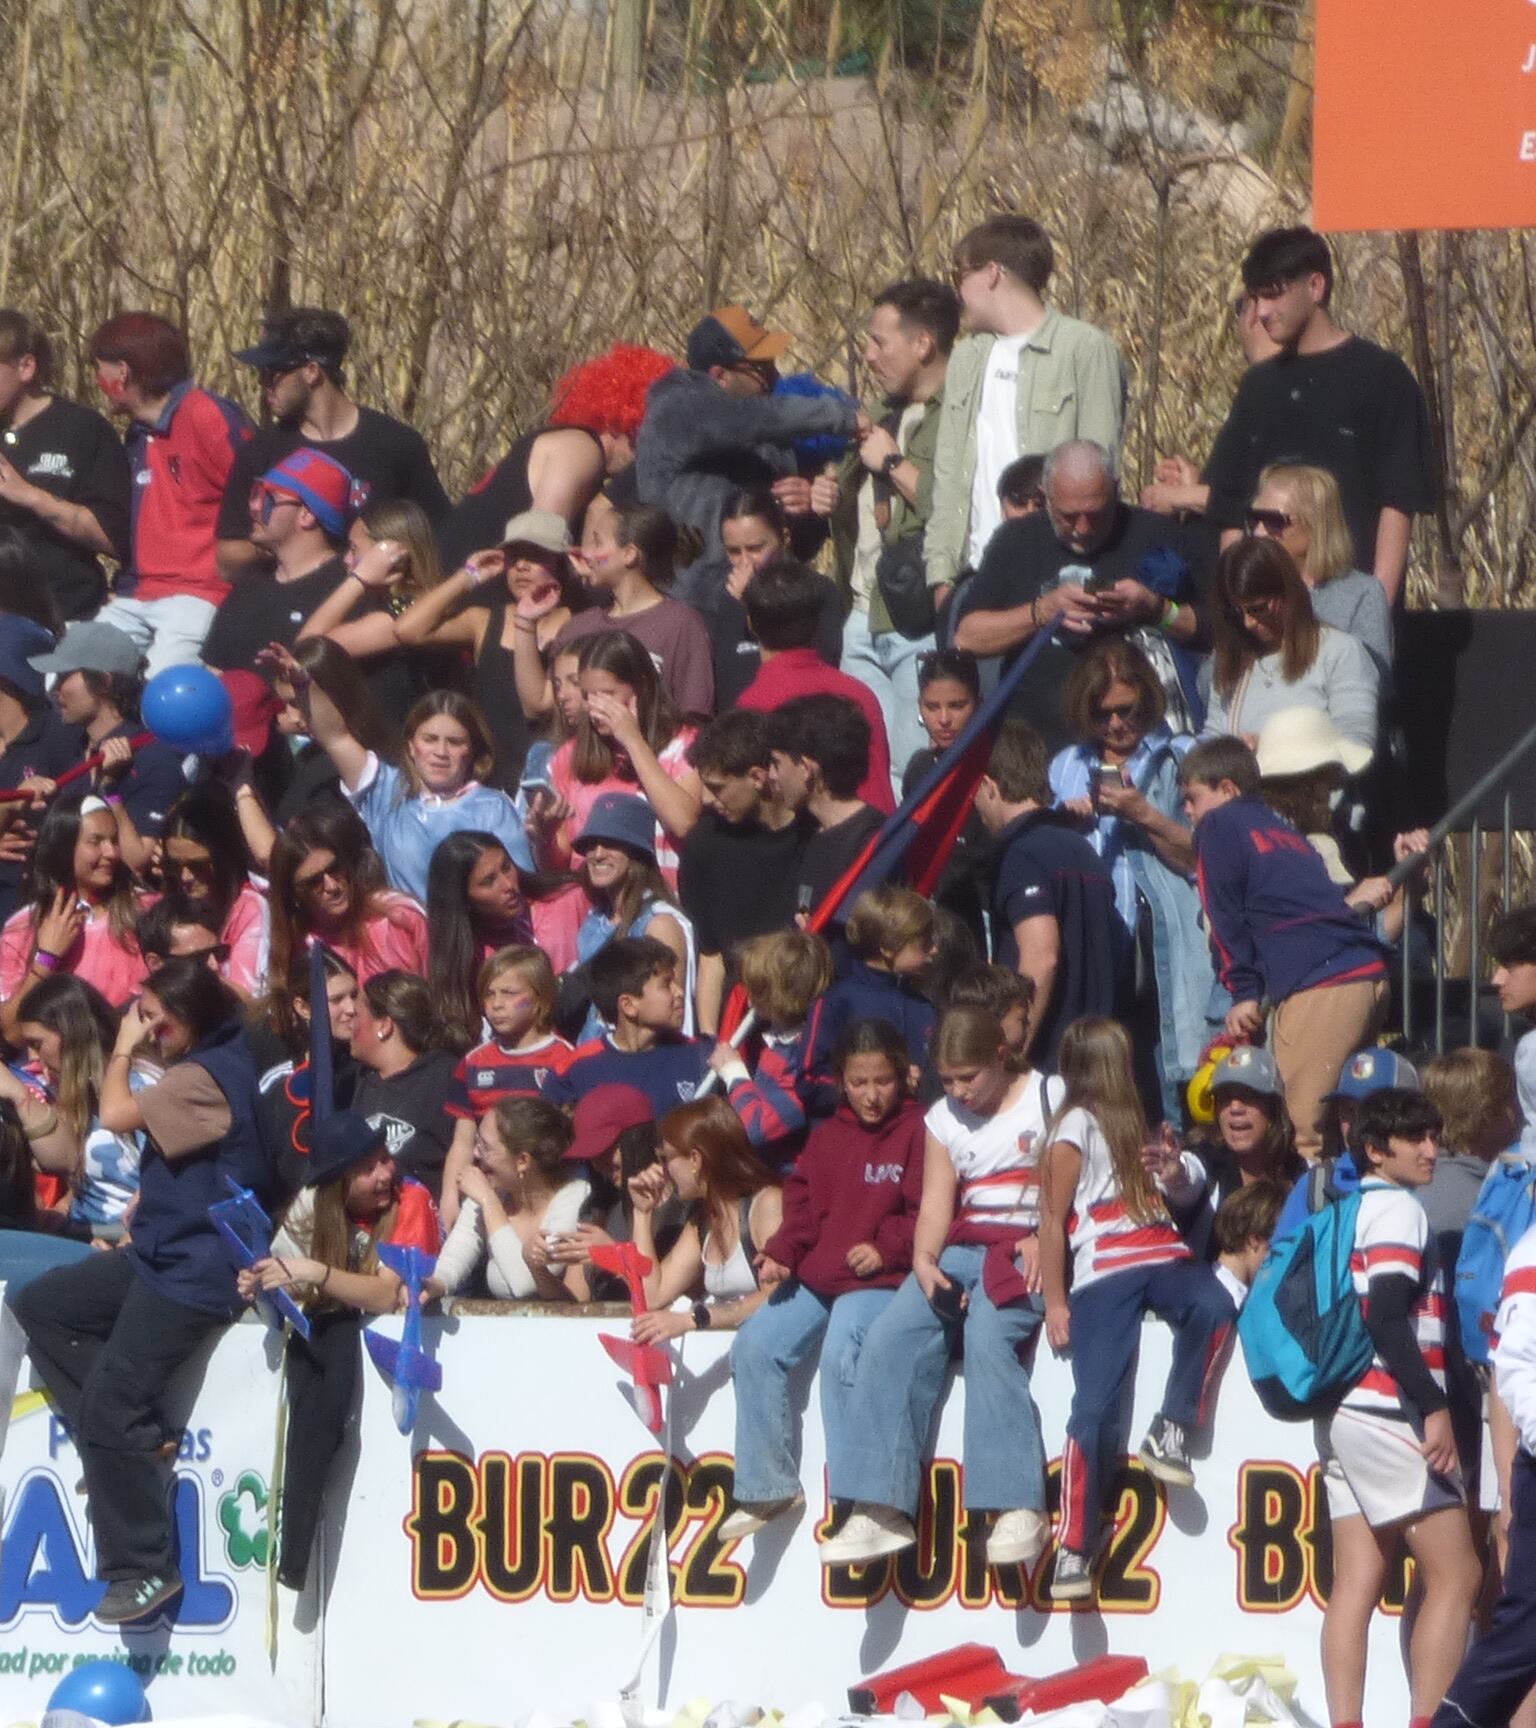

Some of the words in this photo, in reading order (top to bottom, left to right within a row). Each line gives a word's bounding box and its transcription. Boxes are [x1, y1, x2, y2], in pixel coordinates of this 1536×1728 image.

[403, 1450, 747, 1607] BUR22
[29, 1653, 71, 1679] por
[188, 1650, 237, 1676] todo
